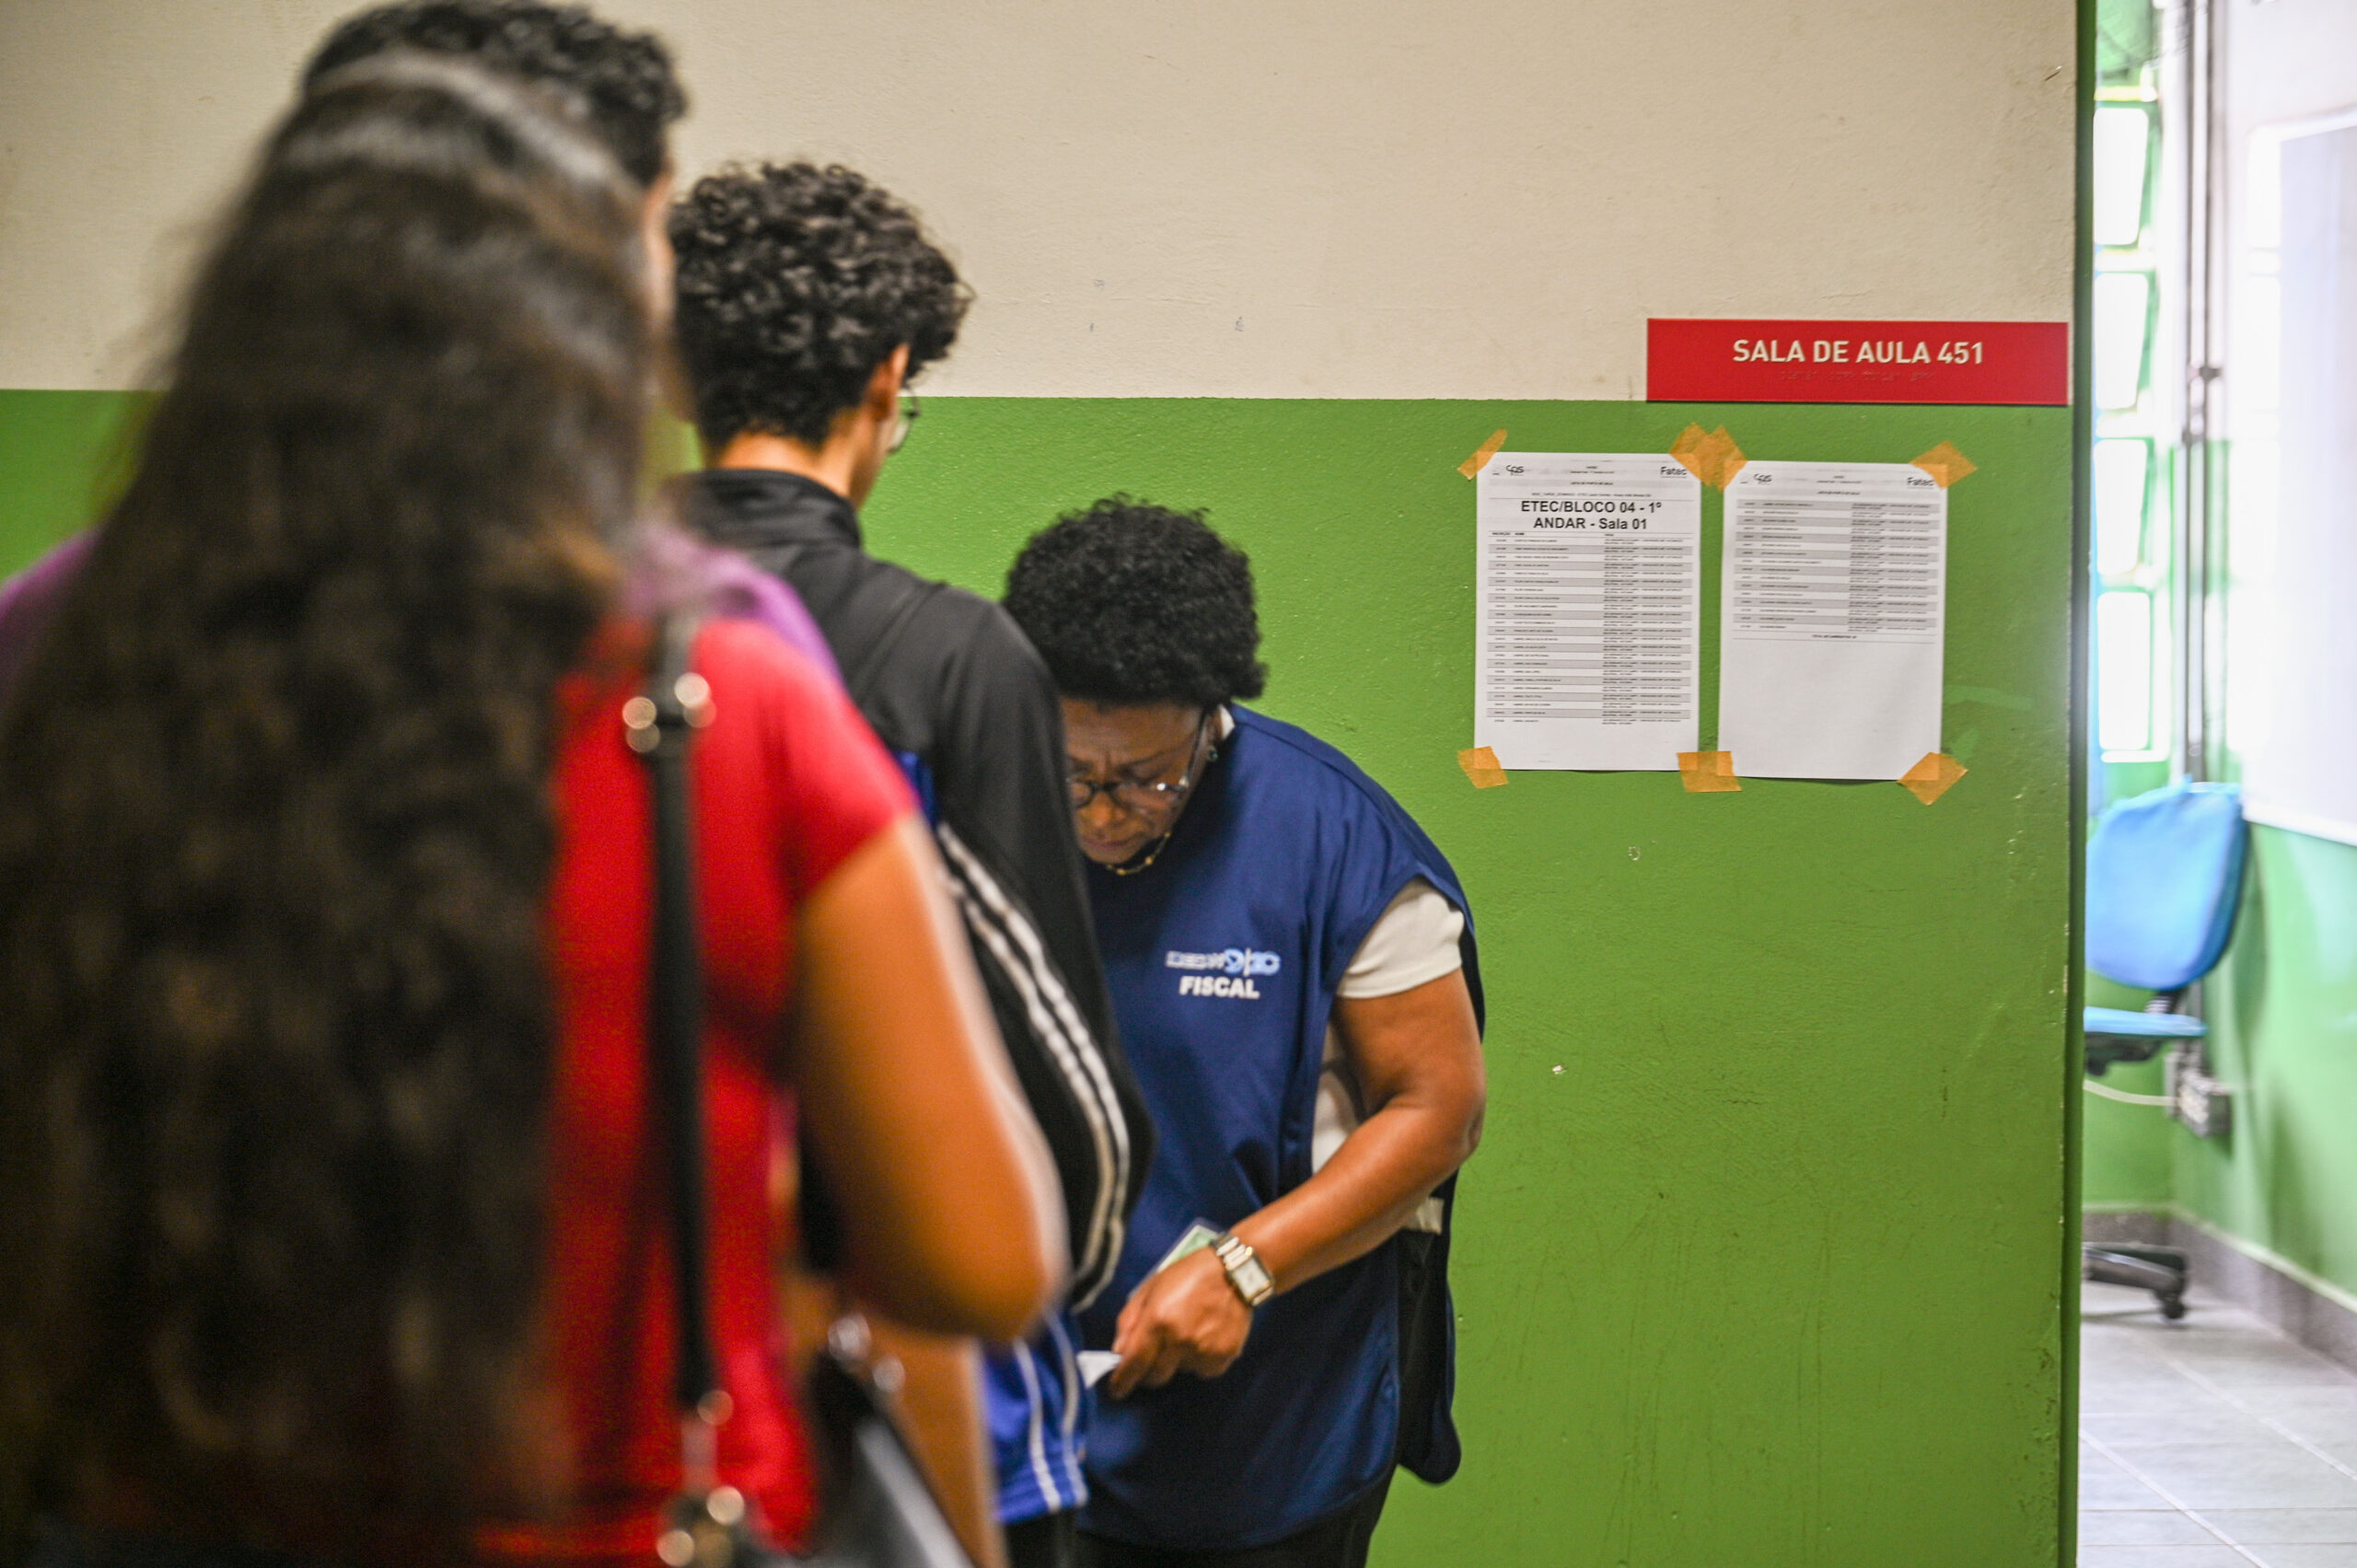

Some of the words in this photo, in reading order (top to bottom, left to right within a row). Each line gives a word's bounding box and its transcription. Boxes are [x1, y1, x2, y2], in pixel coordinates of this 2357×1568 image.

[1733, 339, 1805, 363] SALA
[1812, 340, 1850, 364] DE
[1855, 341, 1932, 365] AULA
[1936, 341, 1983, 365] 451
[1660, 466, 1687, 476] Fatec
[1521, 500, 1616, 513] ETEC/BLOCO
[1620, 502, 1636, 513] 04
[1533, 517, 1585, 529] ANDAR
[1598, 517, 1628, 529] Sala
[1631, 518, 1647, 529] 01
[1178, 975, 1260, 1000] FISCAL
